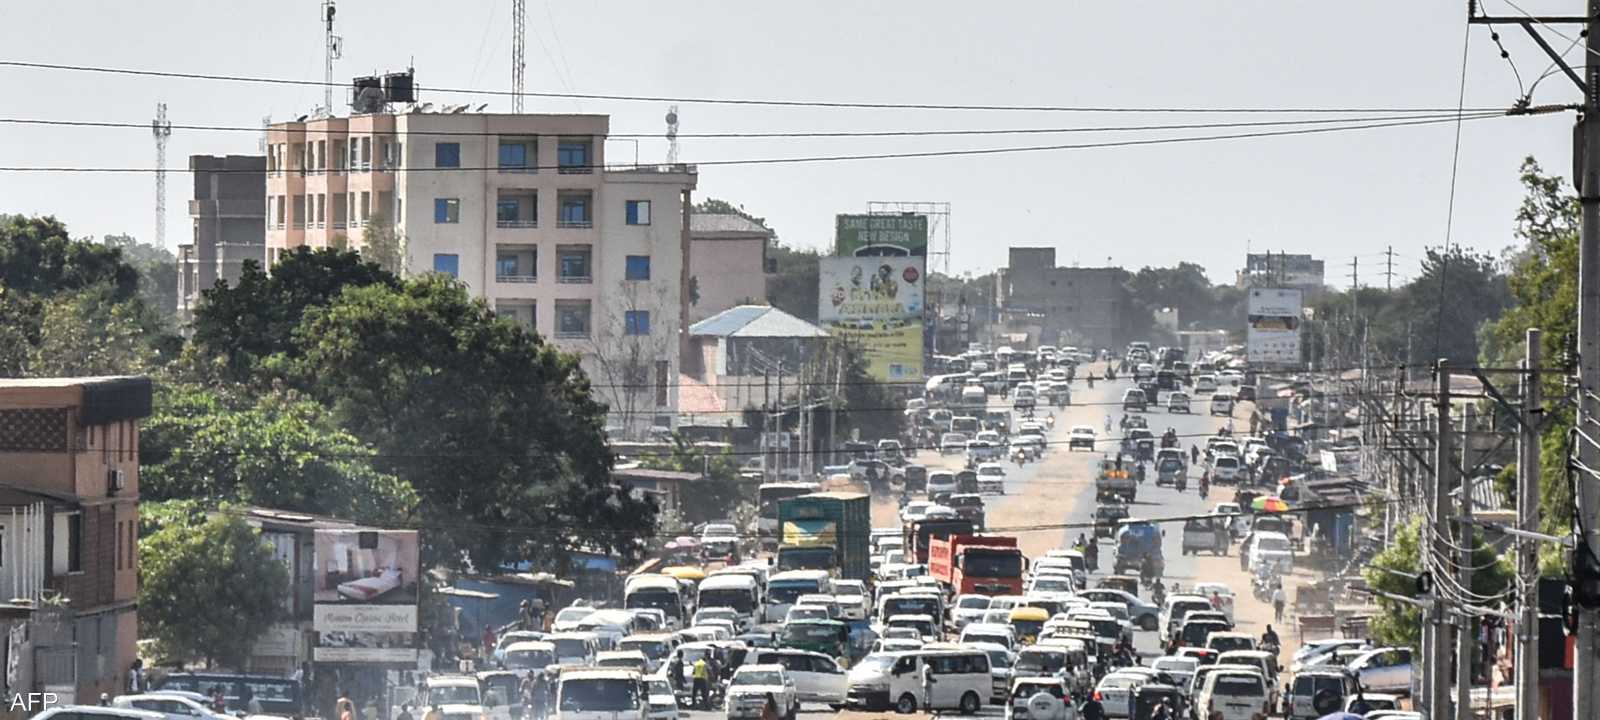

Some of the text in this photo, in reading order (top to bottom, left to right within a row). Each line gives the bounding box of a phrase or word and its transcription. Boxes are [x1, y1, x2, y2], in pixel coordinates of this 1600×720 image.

[844, 217, 924, 230] SAME GREAT TASTE
[857, 231, 911, 242] NEW DESIGN
